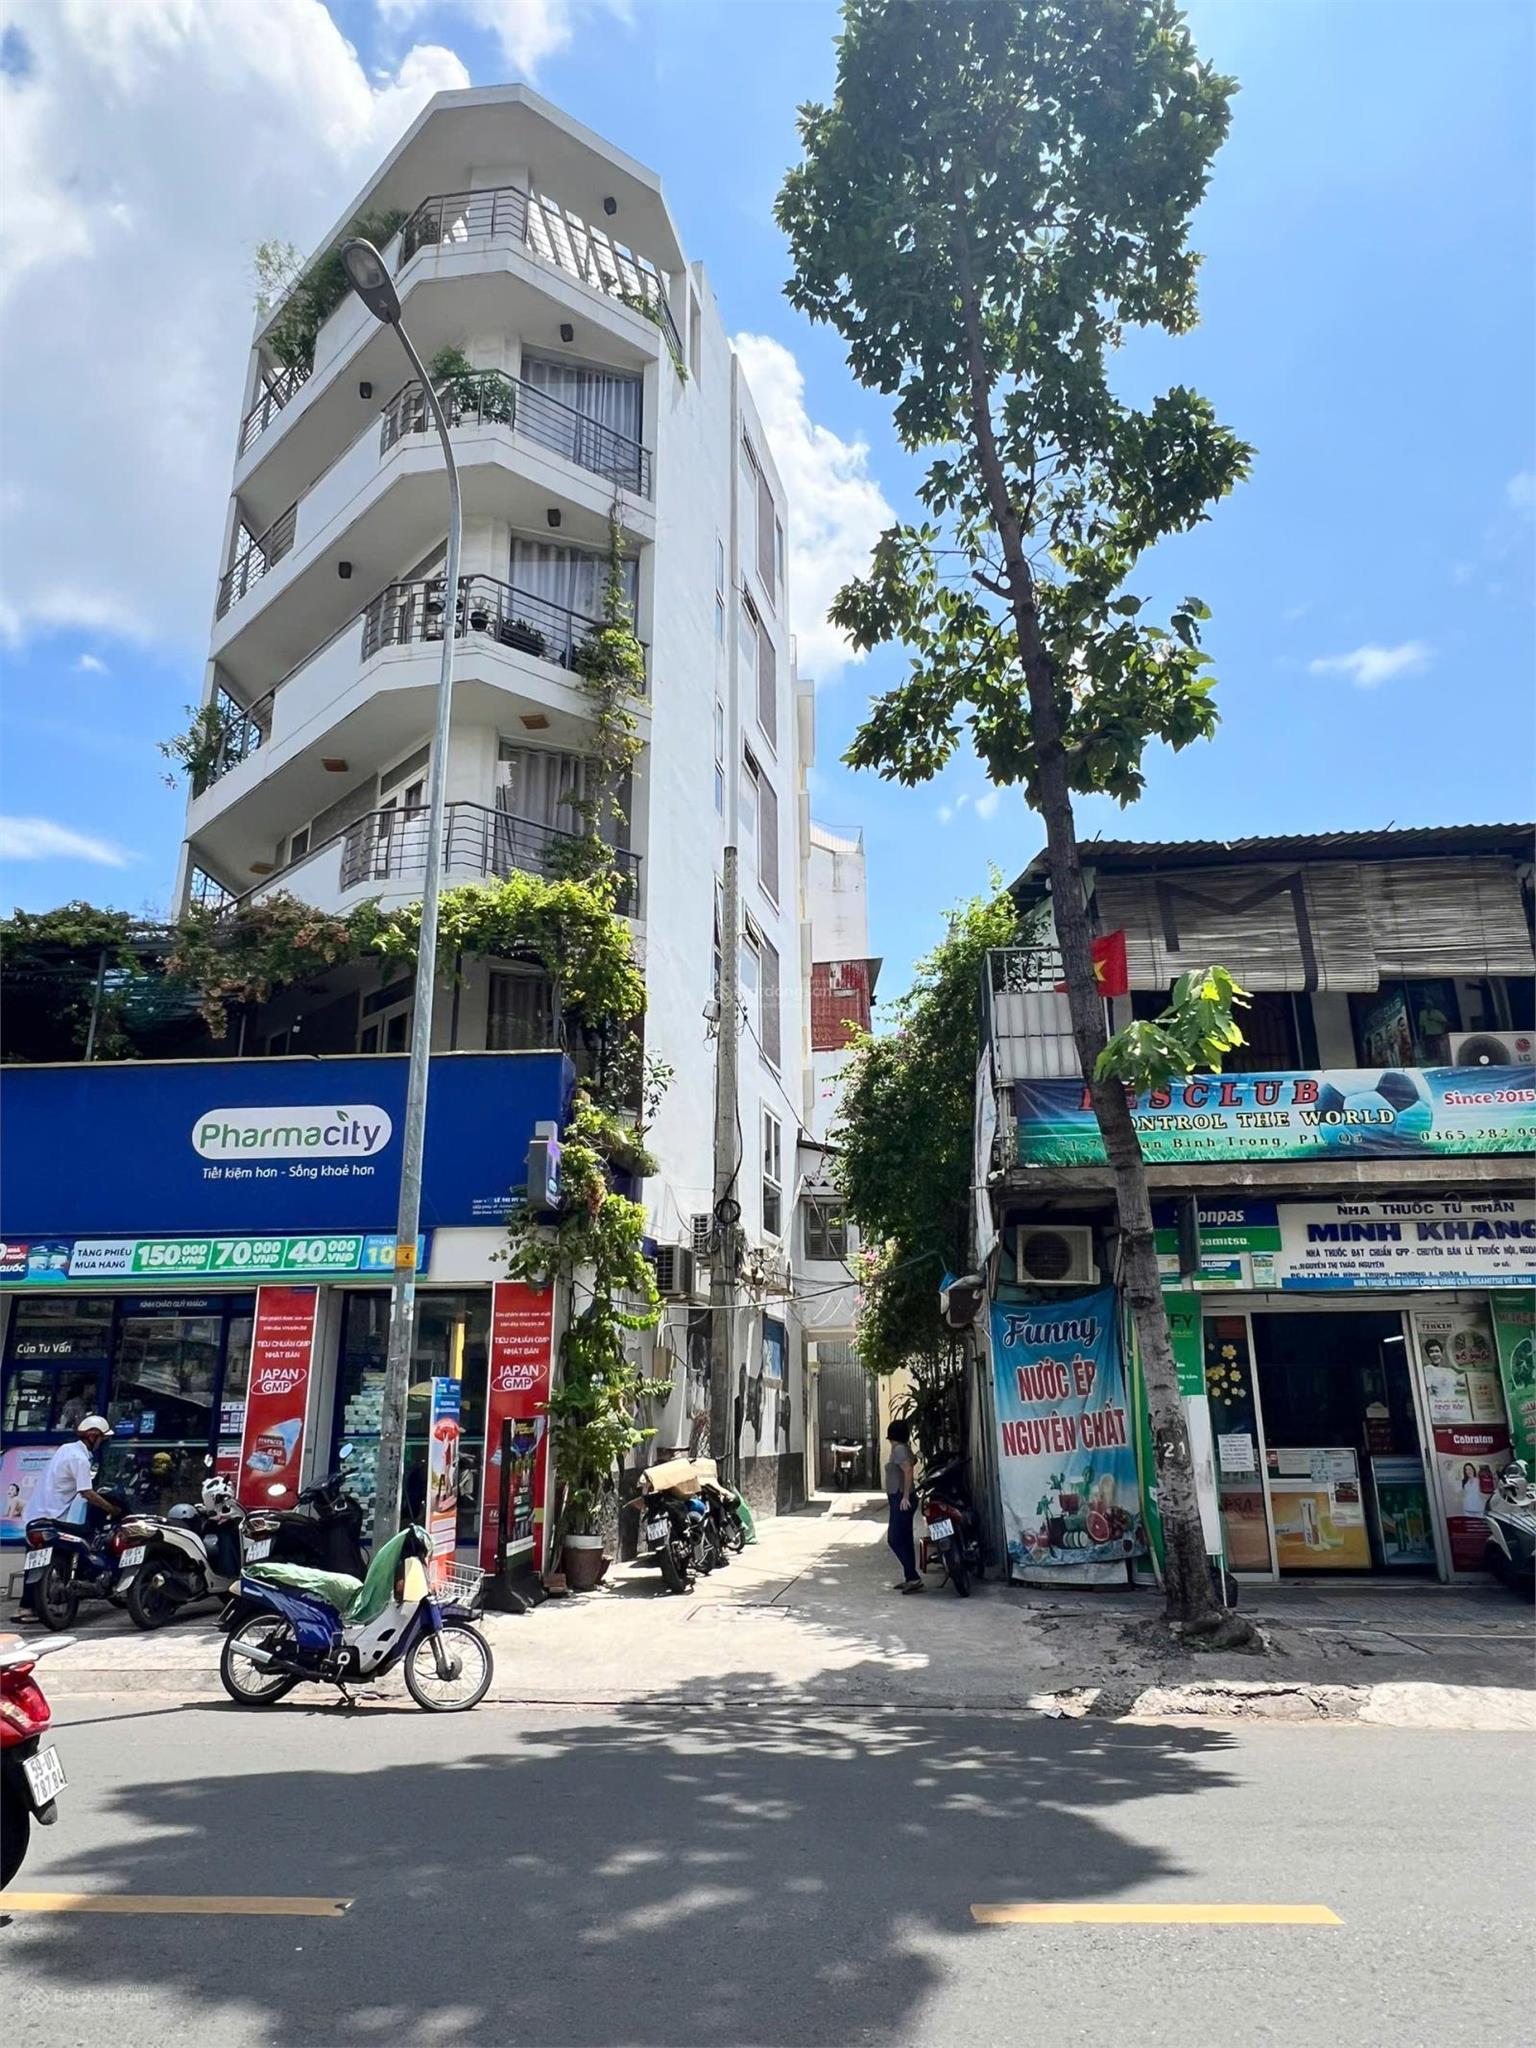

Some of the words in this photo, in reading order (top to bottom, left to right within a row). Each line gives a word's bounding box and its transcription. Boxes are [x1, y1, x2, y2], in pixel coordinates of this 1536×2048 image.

[1444, 1091, 1492, 1105] Since
[1496, 1090, 1536, 1103] 2015
[1237, 1111, 1290, 1128] THE
[1301, 1108, 1396, 1126] WORLD
[199, 1118, 382, 1152] Pharmacity
[202, 1166, 222, 1179] Tiết
[225, 1166, 252, 1180] kiệm
[256, 1166, 277, 1178] hơn
[289, 1164, 318, 1180] Sống
[352, 1164, 375, 1176] hơn
[1306, 1222, 1402, 1243] MINH
[1416, 1219, 1536, 1241] KHANG
[75, 1260, 96, 1269] MUA
[1004, 1312, 1101, 1348] Funny
[259, 1367, 299, 1380] JAPAN
[499, 1364, 539, 1378] JAPAN
[1016, 1357, 1070, 1402] NƯỚC
[1072, 1354, 1097, 1397] ÉP
[263, 1380, 290, 1392] GMP
[503, 1378, 531, 1389] GMP
[1001, 1410, 1077, 1457] NGUYÊN
[1080, 1399, 1128, 1448] CHẤT
